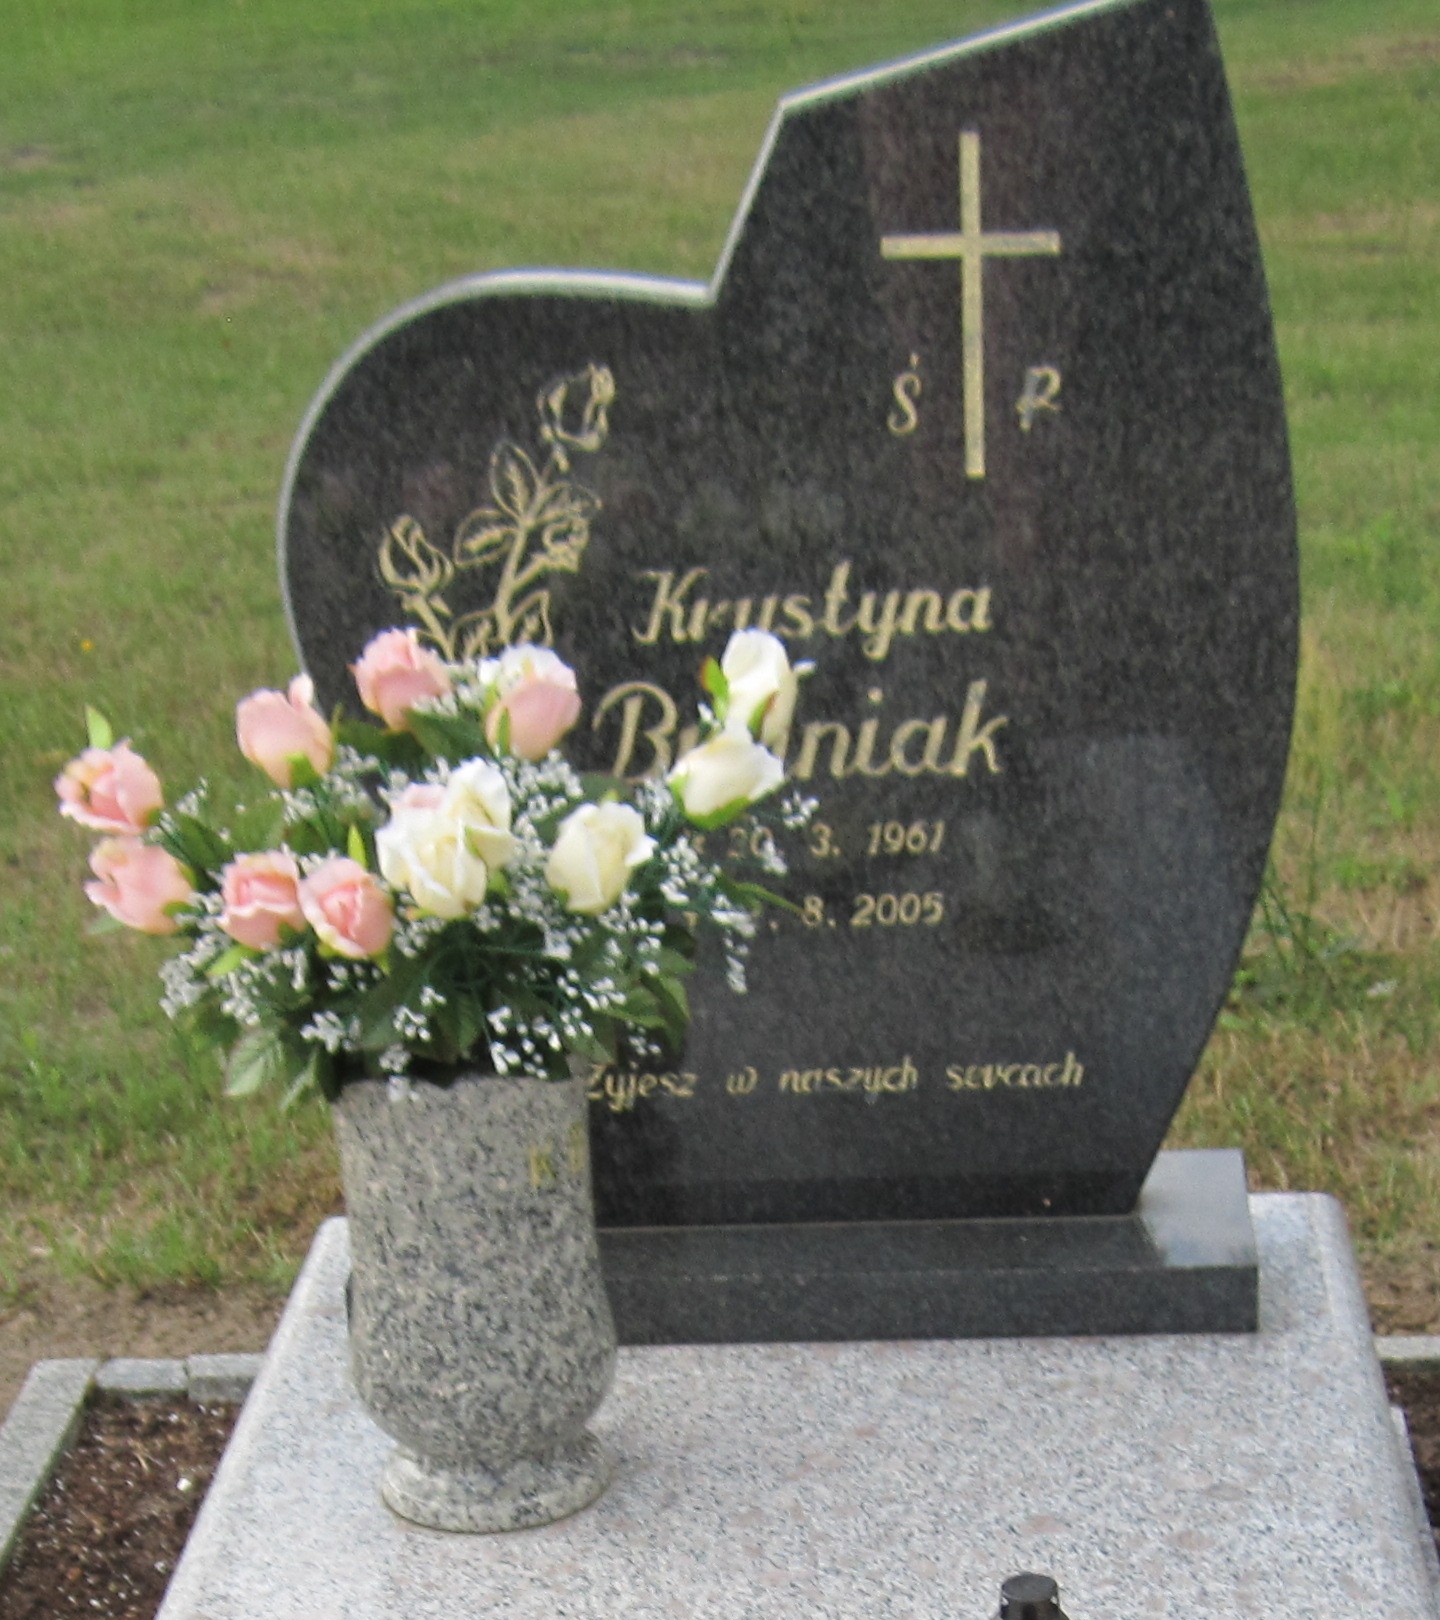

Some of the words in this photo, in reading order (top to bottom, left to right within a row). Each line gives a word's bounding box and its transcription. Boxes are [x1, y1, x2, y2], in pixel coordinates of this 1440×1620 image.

[632, 560, 993, 660] Krystyna
[592, 679, 1009, 779] Bniak
[867, 820, 946, 856] 1961
[850, 891, 945, 926] 2005
[726, 1066, 758, 1095] w
[778, 1055, 917, 1105] naszych
